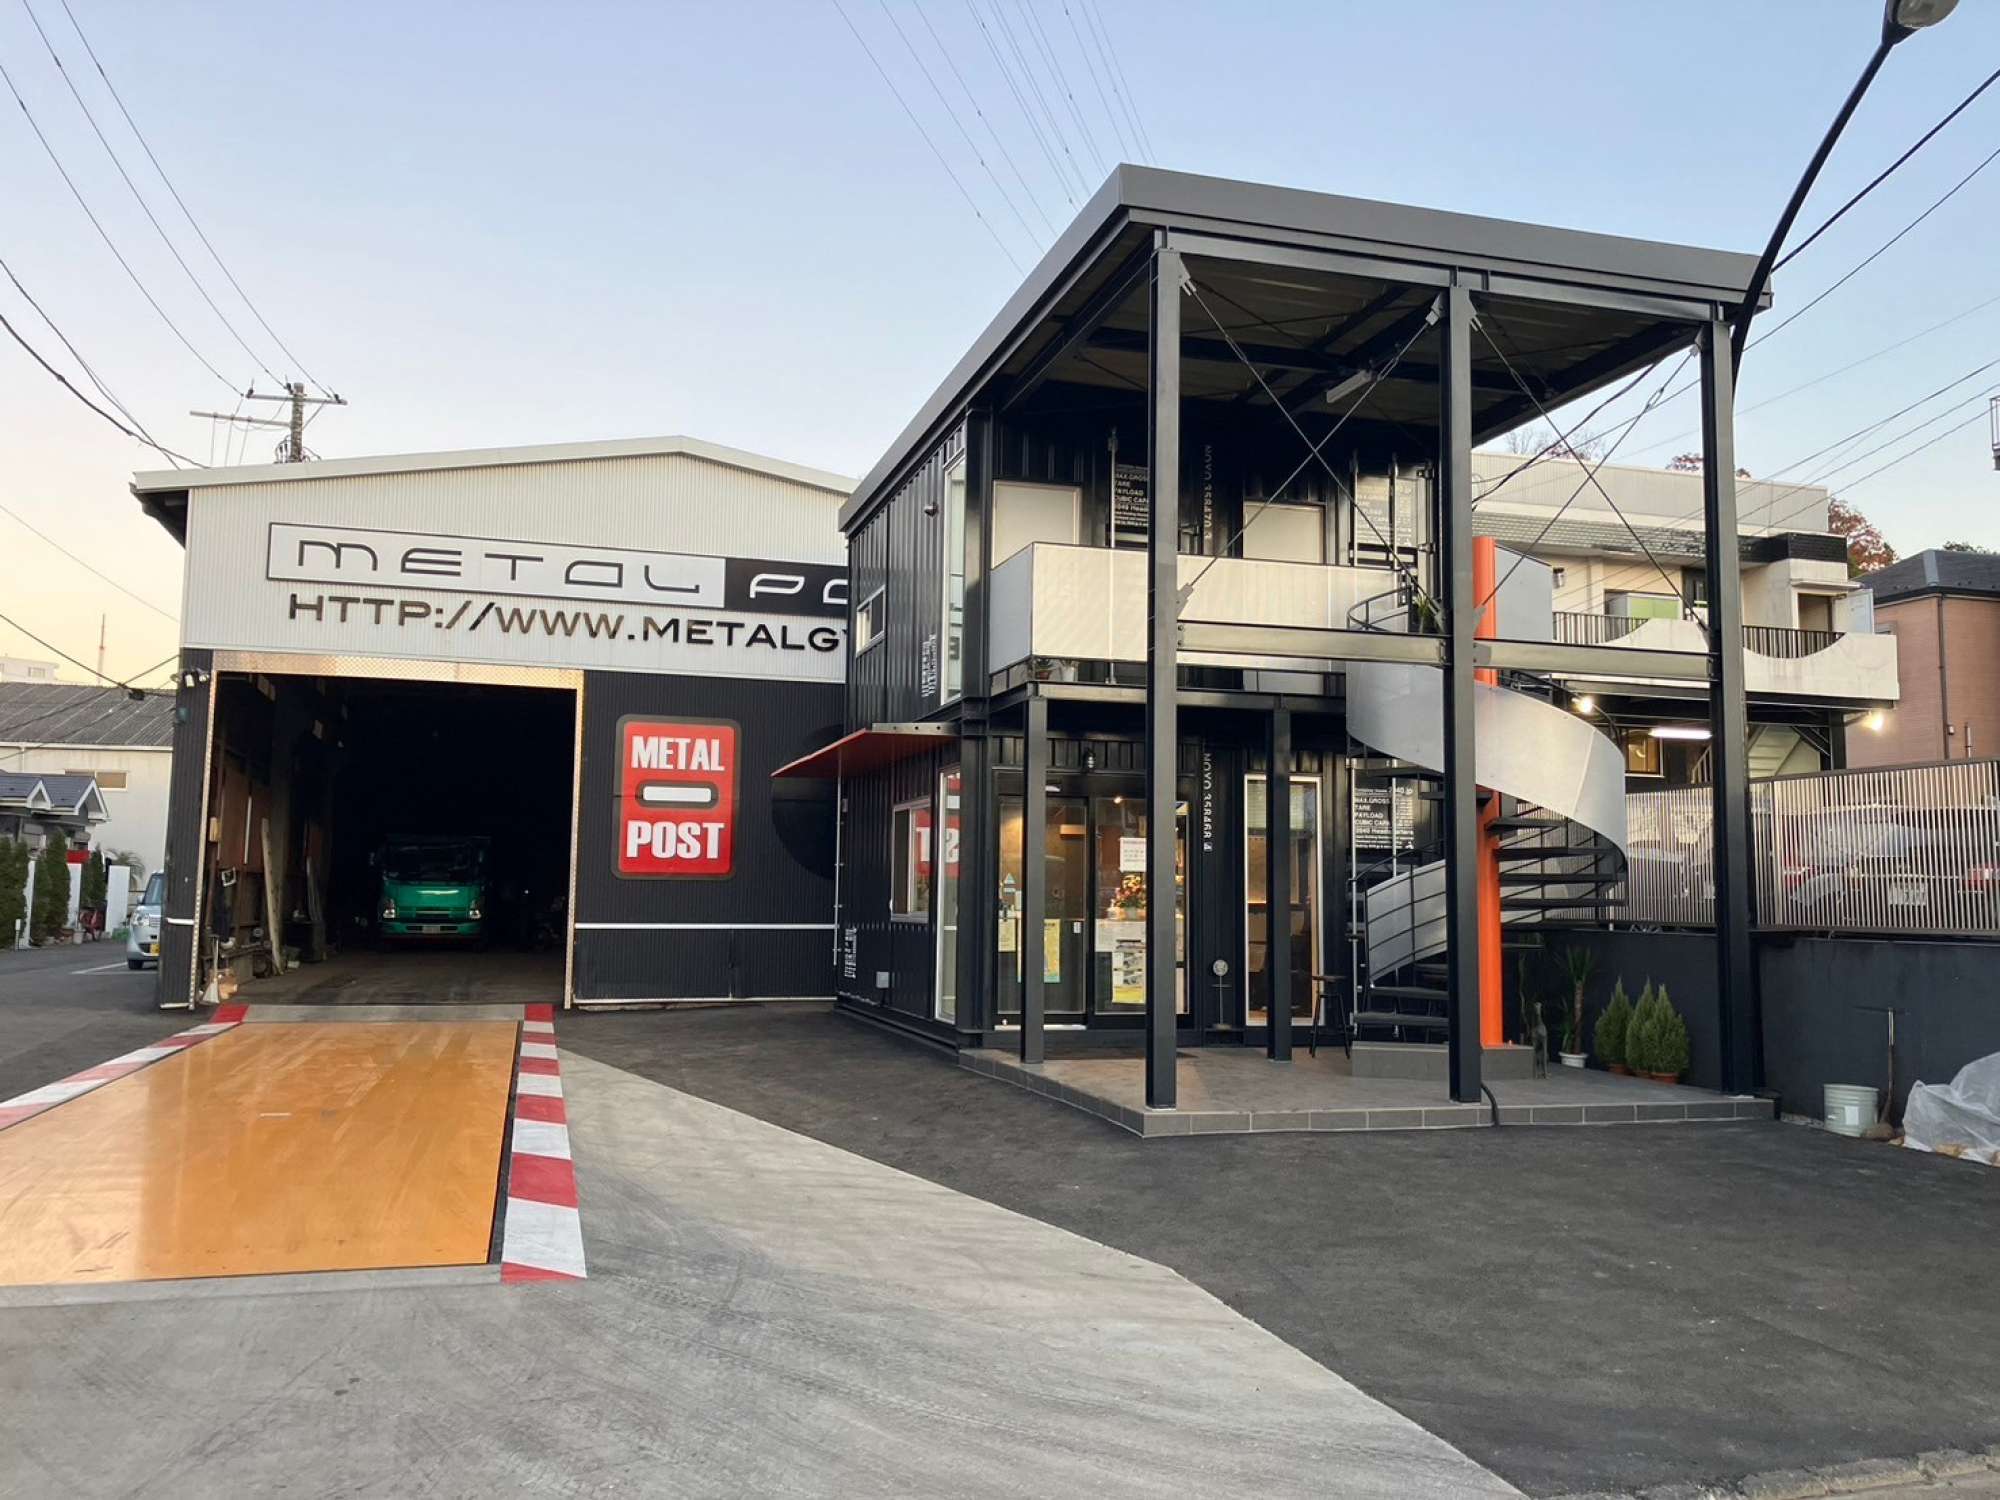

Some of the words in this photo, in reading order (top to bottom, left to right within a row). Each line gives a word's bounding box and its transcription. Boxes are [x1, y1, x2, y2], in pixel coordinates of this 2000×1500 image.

[297, 539, 701, 594] METAL
[288, 593, 848, 653] HTTP://WWW.METALG
[631, 735, 725, 772] METAL
[626, 821, 724, 859] POST
